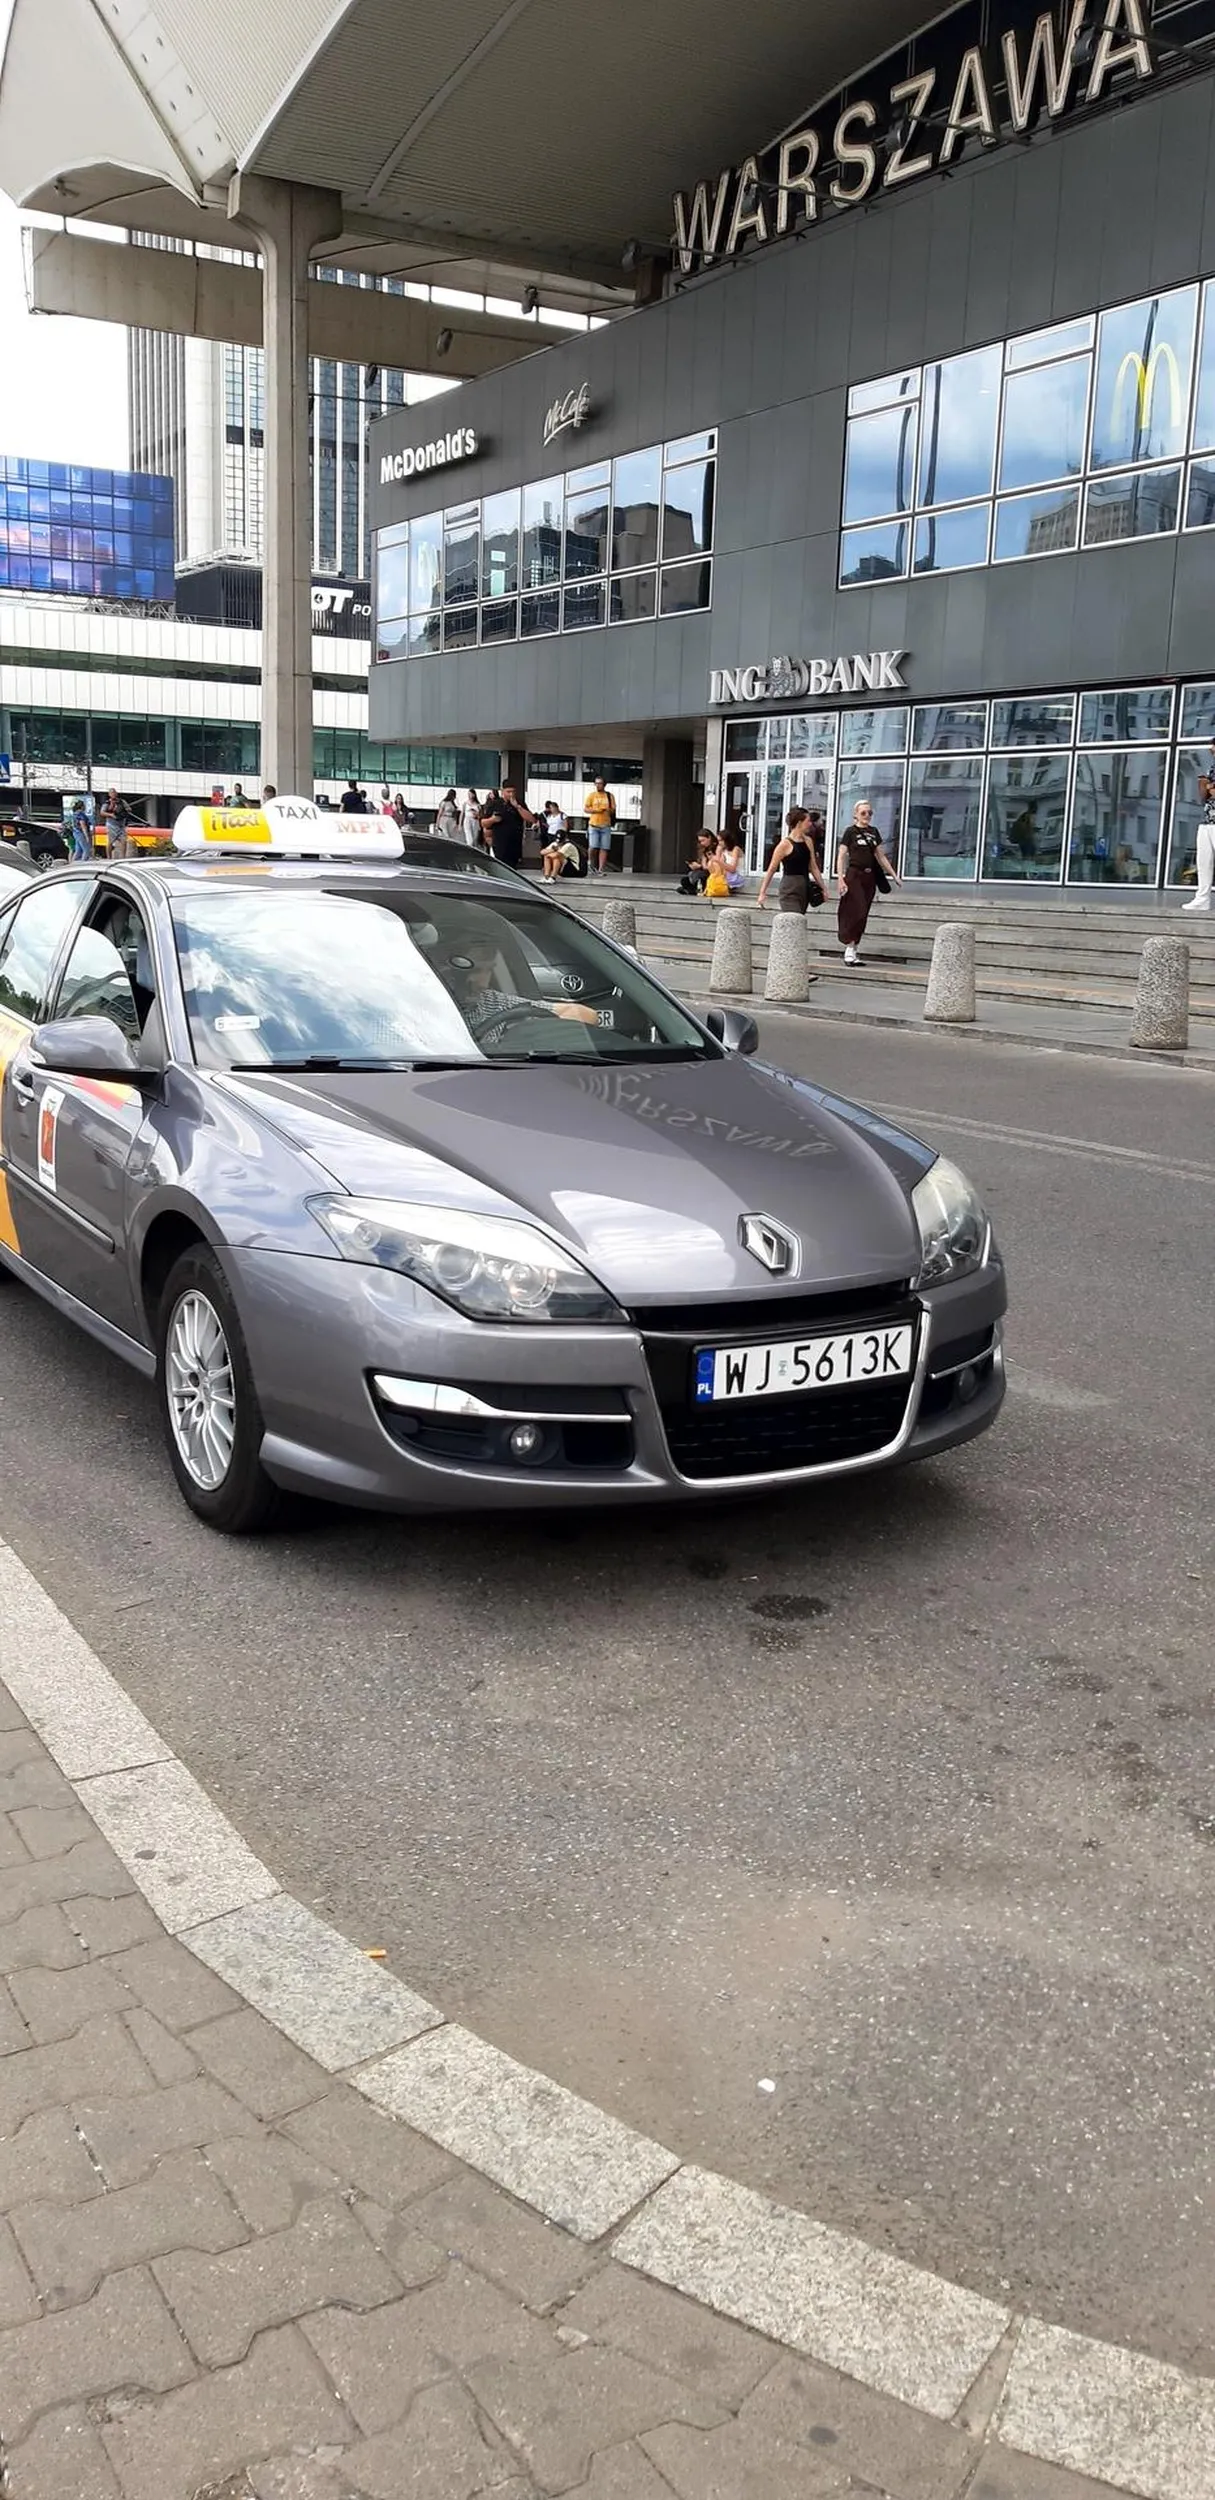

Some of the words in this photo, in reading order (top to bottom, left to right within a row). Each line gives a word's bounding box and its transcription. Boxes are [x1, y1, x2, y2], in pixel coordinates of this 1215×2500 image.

[672, 0, 1153, 275] WARSZAWA
[380, 428, 476, 484] McDonald's
[708, 665, 767, 704] ING
[807, 650, 909, 695] BANK
[275, 805, 318, 820] TAXI
[698, 1384, 711, 1394] PL
[725, 1350, 771, 1395] WJ
[792, 1331, 903, 1386] 5613K
